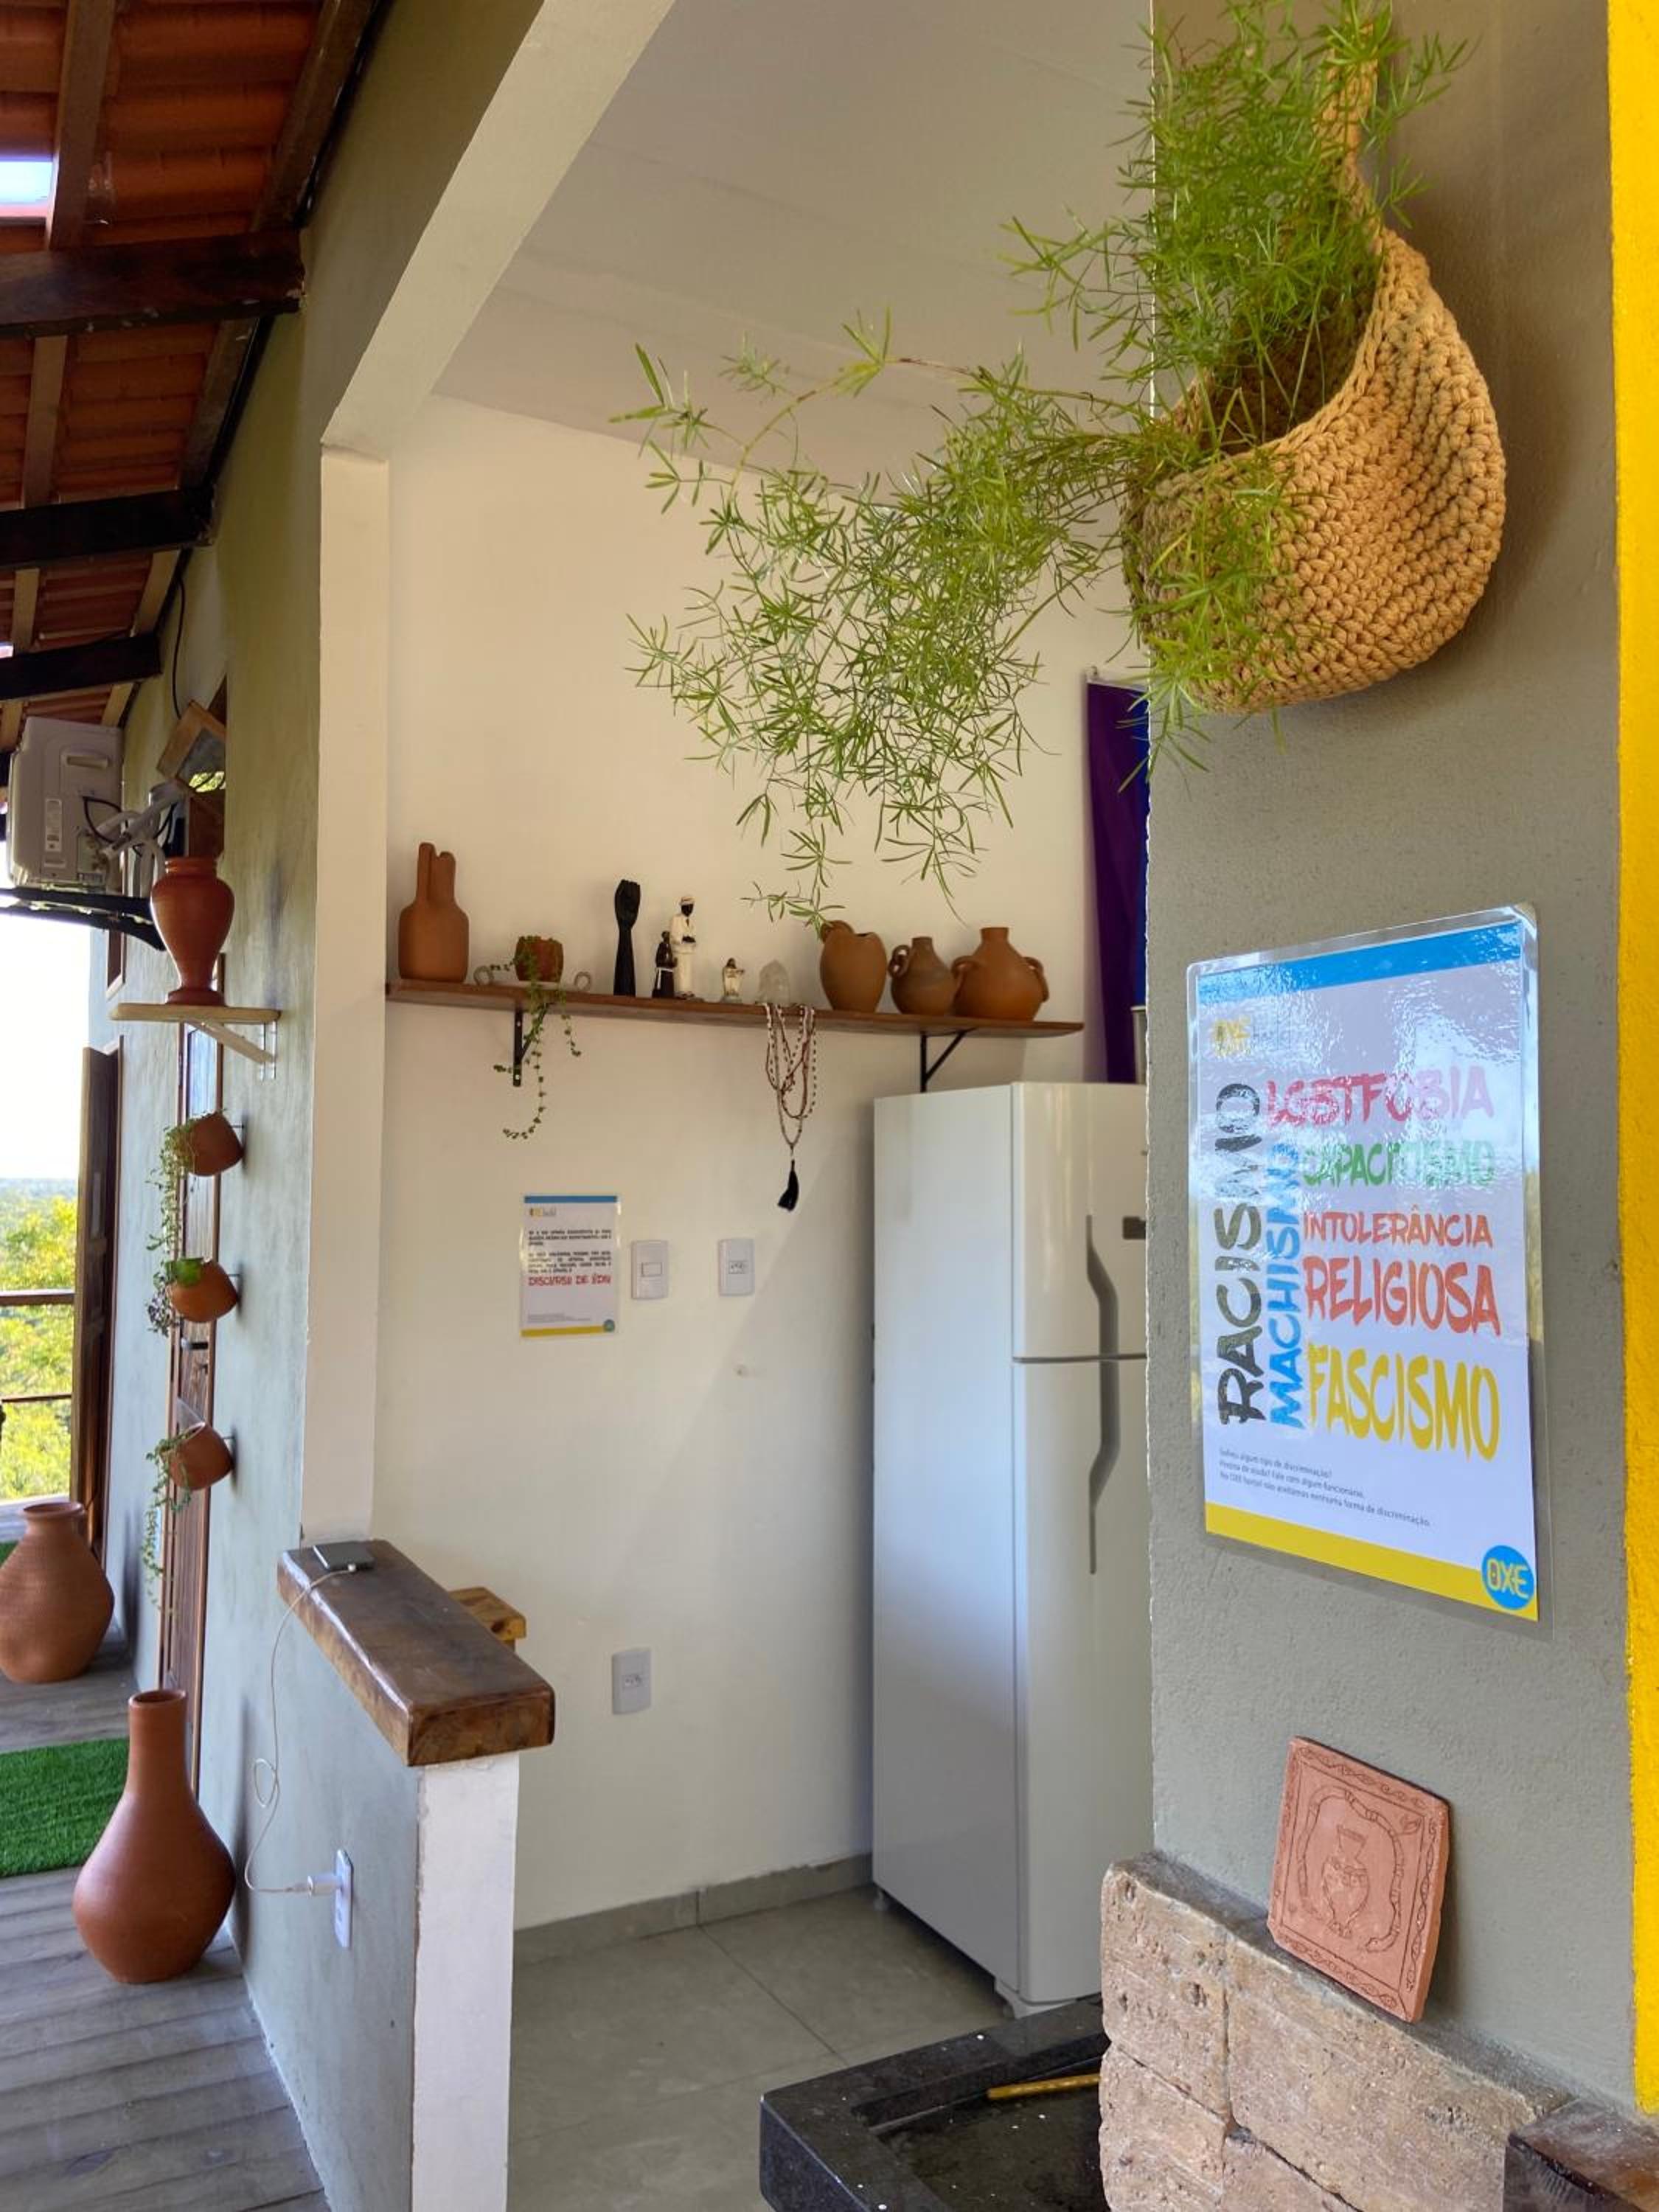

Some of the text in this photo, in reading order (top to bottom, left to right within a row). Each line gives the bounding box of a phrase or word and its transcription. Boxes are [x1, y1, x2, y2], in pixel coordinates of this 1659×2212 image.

[1266, 1065, 1495, 1127] LGBTFOBIA
[1214, 1083, 1266, 1425] RACISMO
[1302, 1204, 1494, 1248] INTOLERÂNCIA
[1266, 1143, 1305, 1430] MACHISMO
[1302, 1256, 1501, 1338] RELIGIOSA
[1306, 1339, 1500, 1462] FASCISMO
[1486, 1557, 1529, 1599] OXE
